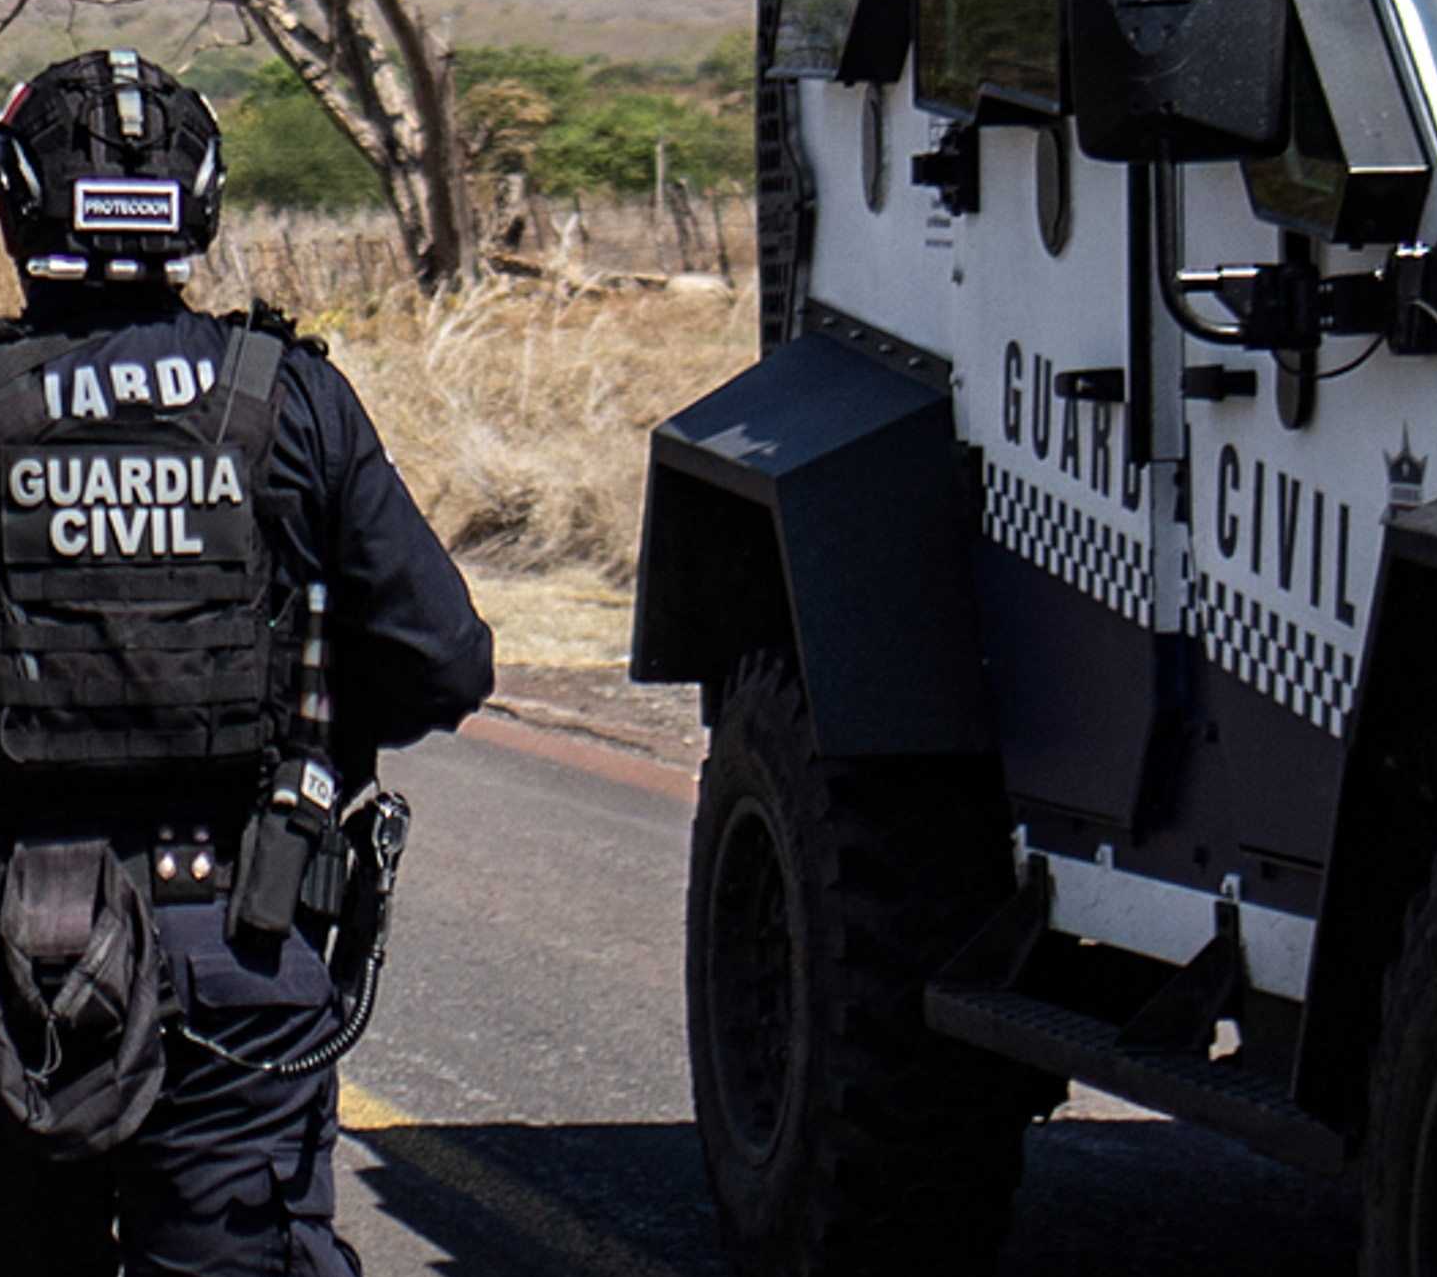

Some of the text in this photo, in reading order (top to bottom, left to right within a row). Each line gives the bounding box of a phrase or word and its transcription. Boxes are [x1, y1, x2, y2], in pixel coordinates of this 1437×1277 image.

[8, 455, 244, 508] GUARDIA
[49, 506, 205, 557] CIVIL
[1216, 443, 1356, 628] CIVIL
